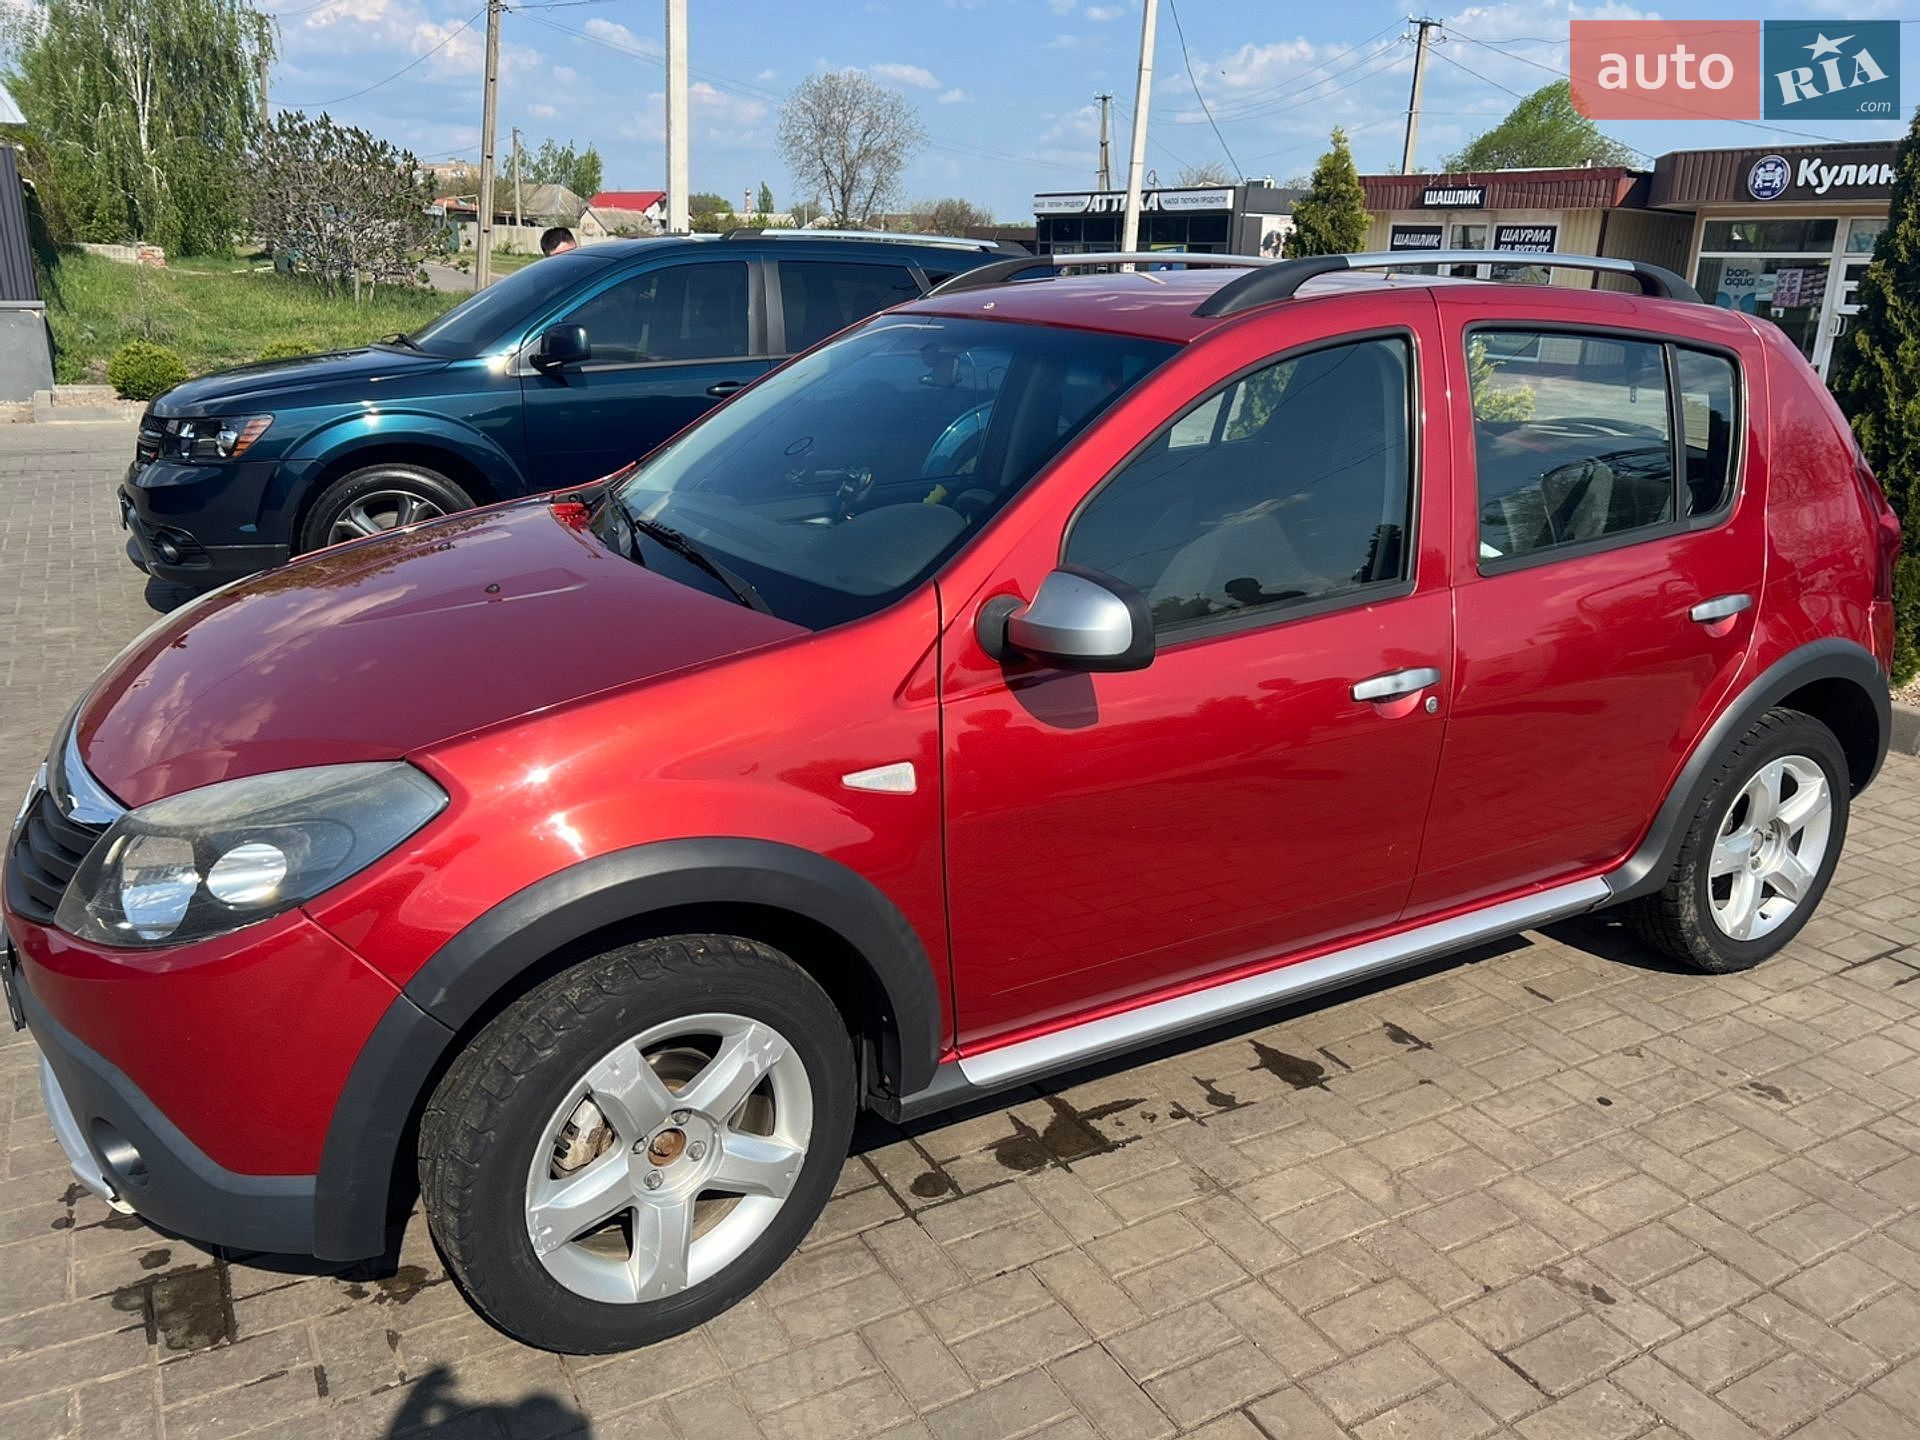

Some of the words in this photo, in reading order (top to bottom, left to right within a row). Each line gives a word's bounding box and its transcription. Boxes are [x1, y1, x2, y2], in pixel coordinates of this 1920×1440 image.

[1424, 189, 1482, 205] ШАШЛИК
[1393, 233, 1442, 247] ШАШЛИК
[1501, 228, 1552, 242] ШАУРМА
[1725, 278, 1754, 289] aqua
